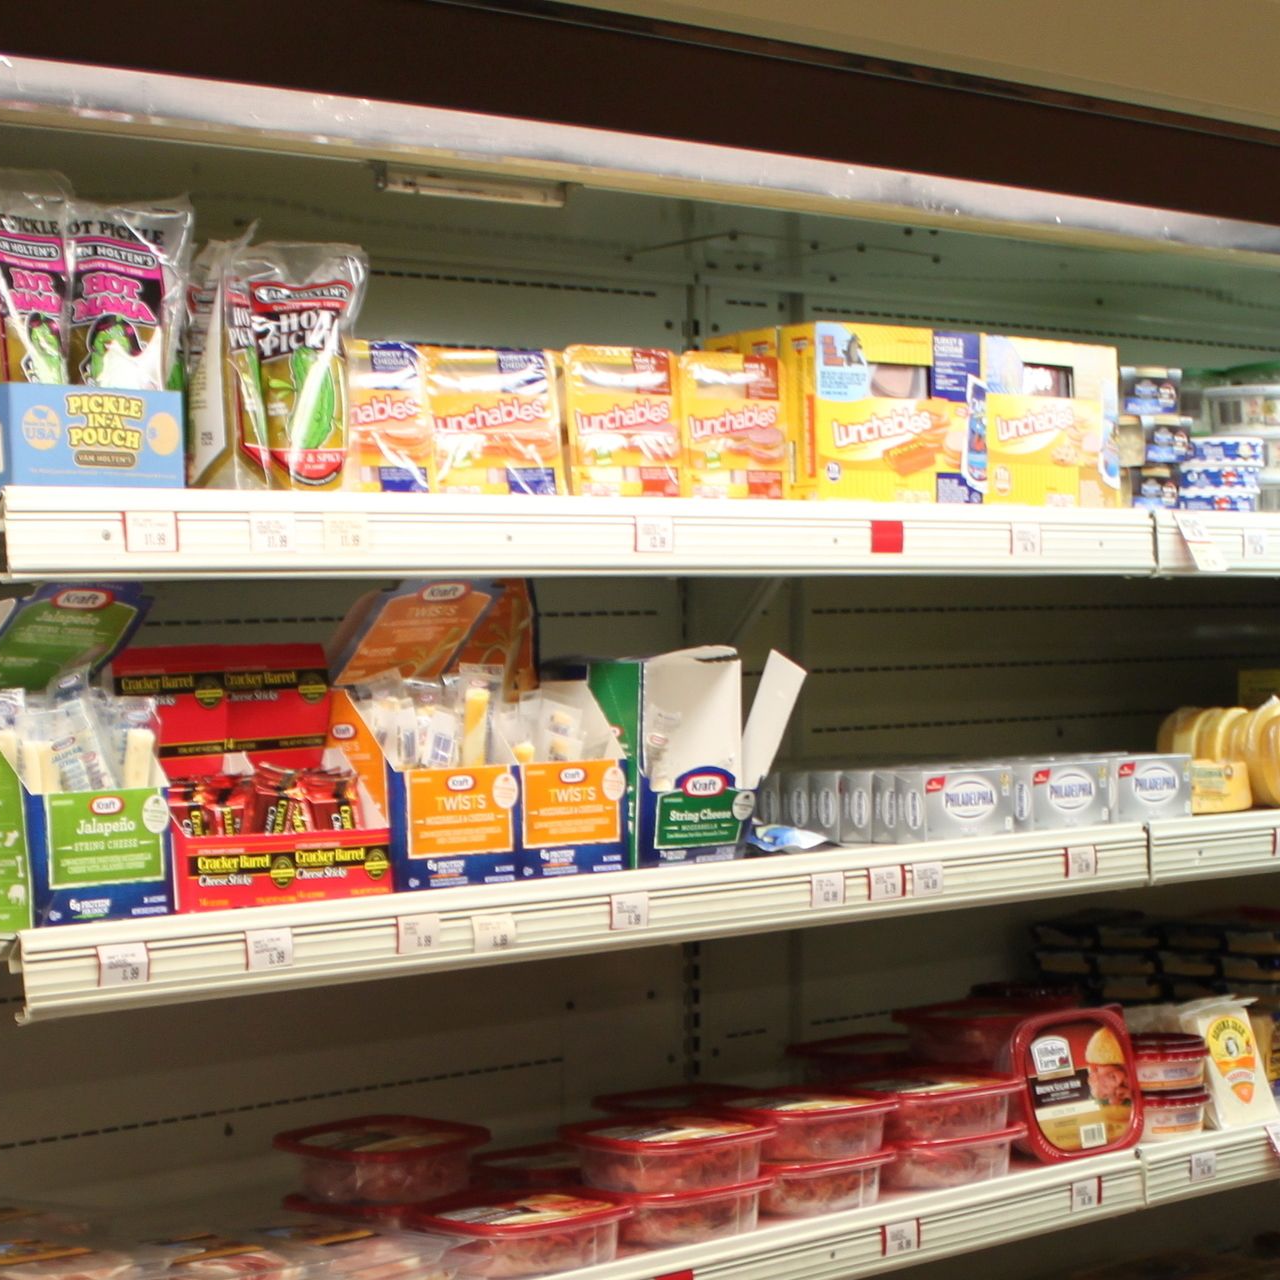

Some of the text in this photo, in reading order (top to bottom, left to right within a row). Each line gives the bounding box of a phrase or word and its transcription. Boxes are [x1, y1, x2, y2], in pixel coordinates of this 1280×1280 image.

[97, 246, 155, 266] HOLTEN'S
[83, 273, 142, 298] HOT
[66, 394, 143, 417] PICKLE
[576, 399, 670, 435] Lunchables
[688, 405, 777, 441] Lunchables
[995, 406, 1074, 441] Lunchables
[831, 408, 933, 448] Lunchables
[69, 426, 141, 449] POUCH
[64, 591, 100, 606] Kraft
[429, 585, 462, 599] Kraft
[121, 675, 194, 692] Cracker Barrel
[264, 671, 298, 685] Barrel
[451, 777, 470, 788] Kraft
[563, 770, 582, 781] Kraft
[1133, 775, 1178, 793] PHILADELPHIA
[690, 777, 718, 793] Kraft
[1048, 781, 1094, 799] PHILADELPHIA
[435, 793, 487, 811] TWISTS
[548, 786, 597, 803] TWISTS
[943, 790, 995, 809] PHILADELPHIA
[95, 798, 118, 810] Kraft
[669, 808, 732, 824] String Cheese
[76, 818, 136, 837] Jalapeño
[74, 839, 139, 852] STRING CHEESE
[197, 854, 270, 872] Cracker Barrel
[295, 847, 366, 864] Cracker Barrel
[198, 873, 254, 887] Cheese Sticks
[295, 867, 348, 881] Cheese Sticks
[1039, 1057, 1058, 1069] Farm
